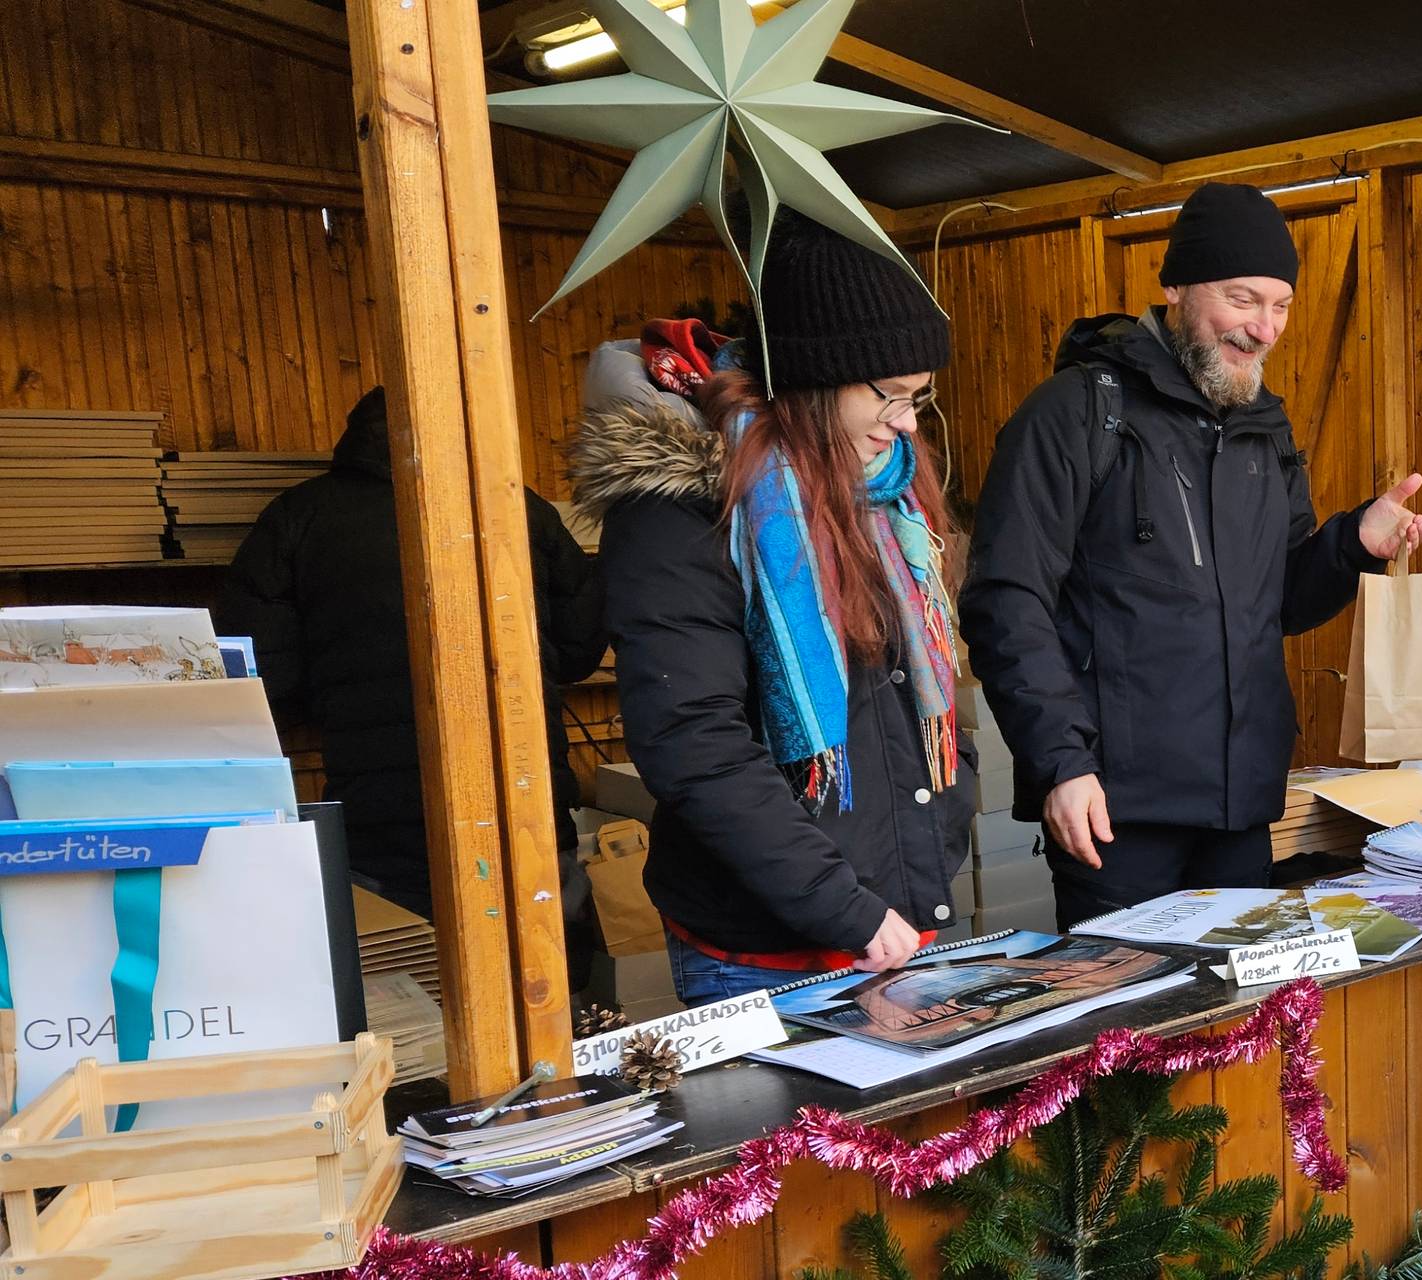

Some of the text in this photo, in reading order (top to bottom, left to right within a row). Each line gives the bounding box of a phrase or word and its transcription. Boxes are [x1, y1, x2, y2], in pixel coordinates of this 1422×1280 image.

[1236, 933, 1350, 963] Monatskalender
[24, 1005, 245, 1050] GRADEL
[574, 1042, 592, 1067] 3
